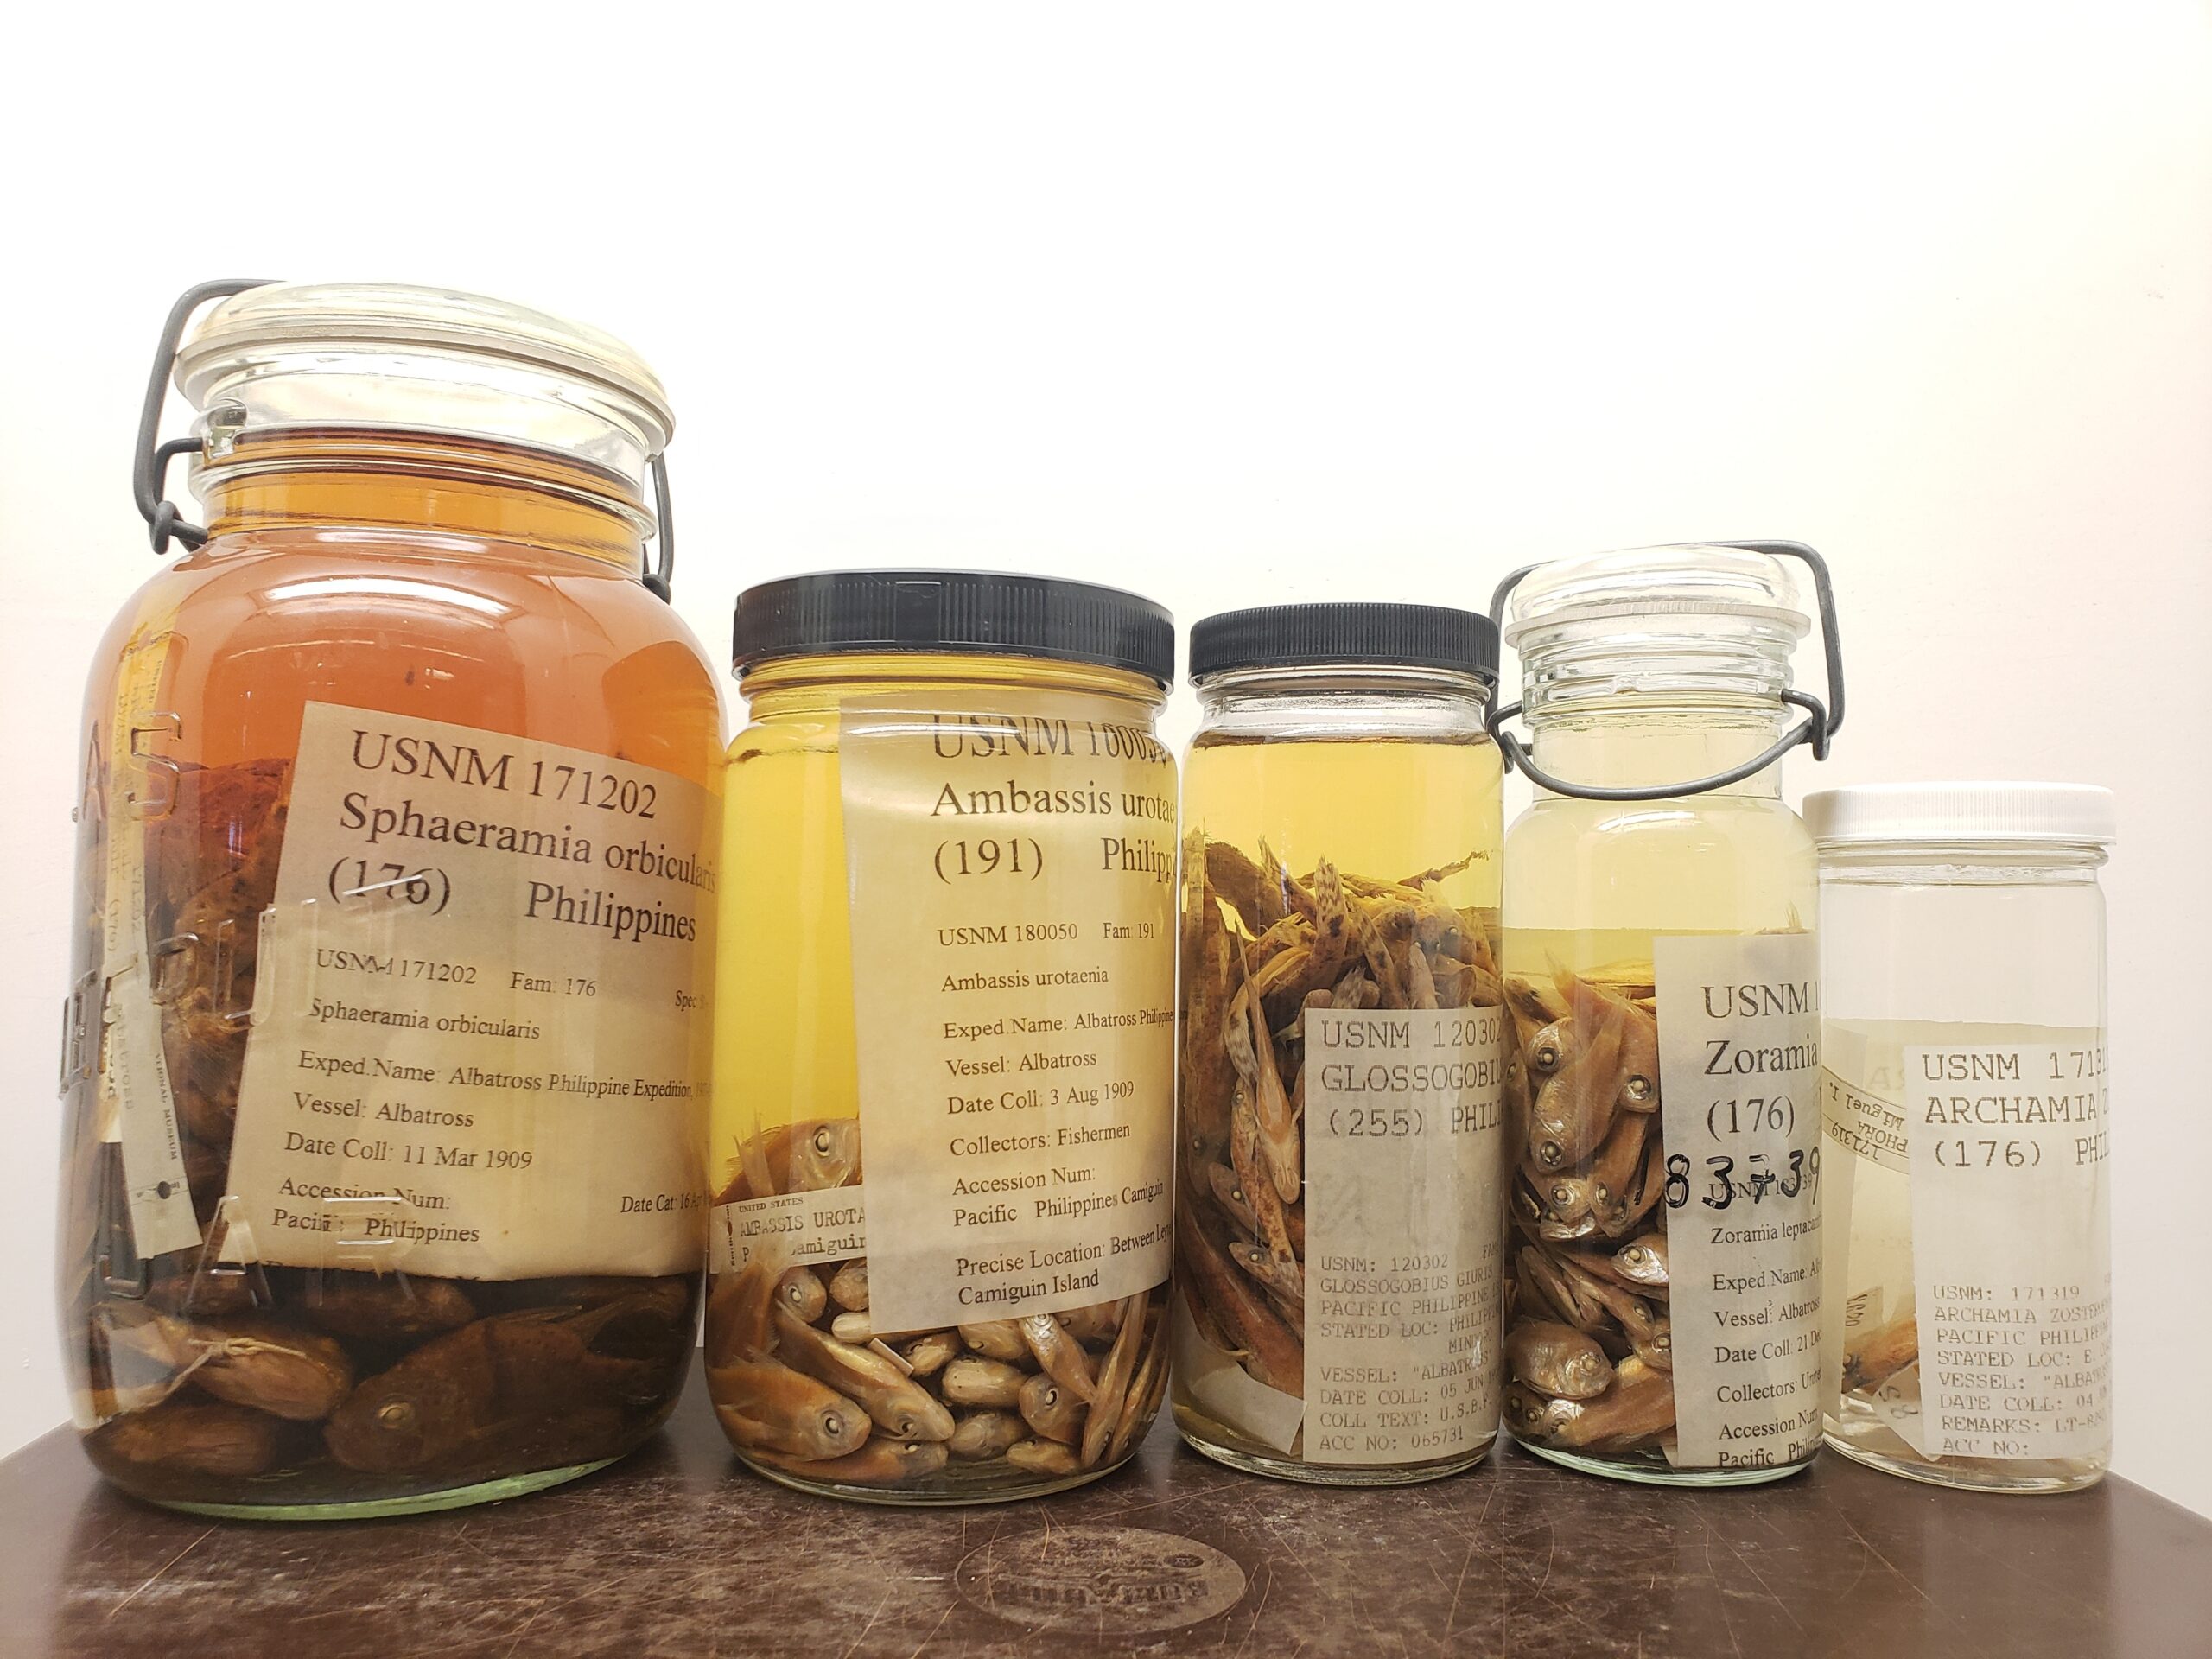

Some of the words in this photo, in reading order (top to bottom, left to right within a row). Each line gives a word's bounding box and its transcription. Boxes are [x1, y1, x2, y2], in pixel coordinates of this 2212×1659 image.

[932, 715, 1074, 759] USNM
[352, 730, 514, 791] USNM
[530, 760, 658, 820] 171202
[931, 779, 1113, 817] Ambassis
[340, 791, 593, 864] Sphaeramia
[604, 842, 717, 893] orbicularis
[935, 838, 1043, 886] (191)
[327, 856, 451, 917] (176)
[524, 880, 697, 943] Philippines
[938, 926, 1008, 946] USNM
[1015, 923, 1078, 942] 180050
[1138, 923, 1154, 939] 191
[316, 949, 393, 976] USNM
[399, 959, 477, 985] 171202
[510, 972, 556, 995] Fam:
[565, 977, 597, 997] 176
[941, 969, 1030, 992] Ambassis
[1036, 966, 1109, 986] urotaenia
[1700, 982, 1808, 1019] USNM
[309, 997, 429, 1030] Sphaeramia
[436, 1014, 540, 1039] orbicularis
[1074, 1013, 1136, 1030] Albatross
[1140, 1007, 1173, 1028] Philippine
[1322, 1020, 1409, 1049] USNM
[945, 1056, 1011, 1077] Vessel:
[1019, 1052, 1097, 1071] Albatross
[1704, 1033, 1818, 1075] Zoramia
[1922, 1053, 2020, 1080] USNM
[449, 1066, 542, 1091] Albatross
[547, 1072, 630, 1098] Philippine
[293, 1091, 367, 1120] Vessel:
[375, 1102, 474, 1128] Albatross
[948, 1095, 994, 1115] Date
[1001, 1090, 1043, 1110] Coll:
[1050, 1089, 1059, 1106] 3
[1066, 1086, 1099, 1106] Aug
[1104, 1081, 1135, 1100] 1909
[1925, 1092, 2097, 1124] ARCHAMIA
[1330, 1109, 1422, 1136] (255)
[1707, 1095, 1795, 1143] (176)
[1846, 1094, 1905, 1132] Miguel
[162, 1108, 179, 1160] MUSEUM
[950, 1134, 1052, 1156] Collectors:
[1057, 1124, 1130, 1147] Fishermen
[1832, 1122, 1882, 1160] 171319
[285, 1131, 336, 1157] Date
[343, 1138, 393, 1163] Coll:
[404, 1145, 426, 1166] 11
[435, 1147, 479, 1168] Mar
[486, 1150, 533, 1170] 1909
[1935, 1140, 2041, 1167] (176)
[278, 1177, 387, 1202] Accession
[392, 1188, 451, 1211] Num:
[620, 1196, 652, 1213] Date
[952, 1171, 1047, 1196] Accession
[1052, 1167, 1096, 1185] Num:
[738, 1201, 766, 1213] UNITED
[770, 1197, 804, 1209] STATES
[953, 1204, 1018, 1227] Pacific
[1034, 1192, 1118, 1218] Philippines
[1122, 1179, 1164, 1205] Camiguin
[364, 1217, 480, 1246] Philippines
[1711, 1224, 1778, 1244] Zoramia
[956, 1252, 1024, 1277] Precise
[1030, 1242, 1106, 1269] Location:
[1110, 1228, 1155, 1255] Between
[1321, 1255, 1376, 1273] USNM:
[1391, 1254, 1448, 1272] 120302
[958, 1278, 1047, 1305] Camiguin
[1053, 1268, 1099, 1294] Island
[1320, 1275, 1448, 1294] GLOSSOGOBIUS
[1457, 1264, 1492, 1287] GIURIS
[1934, 1285, 1992, 1300] USNM:
[2012, 1285, 2080, 1301] 171319
[1321, 1300, 1401, 1317] PACIFIC
[1411, 1286, 1488, 1315] PHILIPPINE
[1934, 1306, 2037, 1324] ARCHAMIA
[1321, 1323, 1389, 1338] STATED
[1401, 1322, 1438, 1338] LOC:
[1713, 1306, 1772, 1328] Vessel:
[1715, 1345, 1757, 1363] Date
[1762, 1339, 1793, 1359] Coll:
[1797, 1334, 1808, 1352] 21
[1936, 1328, 2026, 1345] PACIFIC
[1937, 1350, 2014, 1367] STATED
[2027, 1351, 2071, 1367] LOC:
[1320, 1366, 1397, 1382] VESSEL:
[1938, 1372, 2025, 1389] VESSEL:
[1320, 1389, 1366, 1405] DATE
[1378, 1389, 1428, 1405] COLL:
[1440, 1382, 1456, 1399] 05
[1465, 1375, 1484, 1394] JUN
[1939, 1394, 1990, 1410] DATE
[2004, 1396, 2062, 1411] COLL:
[2076, 1393, 2093, 1408] 04
[1320, 1412, 1366, 1427] COLL
[1377, 1410, 1428, 1427] TEXT:
[1719, 1417, 1795, 1440] Accession
[1942, 1416, 2040, 1433] REMARKS:
[1319, 1435, 1354, 1451] ACC
[1366, 1435, 1397, 1451] NO:
[1411, 1426, 1464, 1448] 065731
[1943, 1437, 1980, 1453] ACC
[1993, 1440, 2030, 1455] NO:
[1718, 1449, 1774, 1468] Pacific
